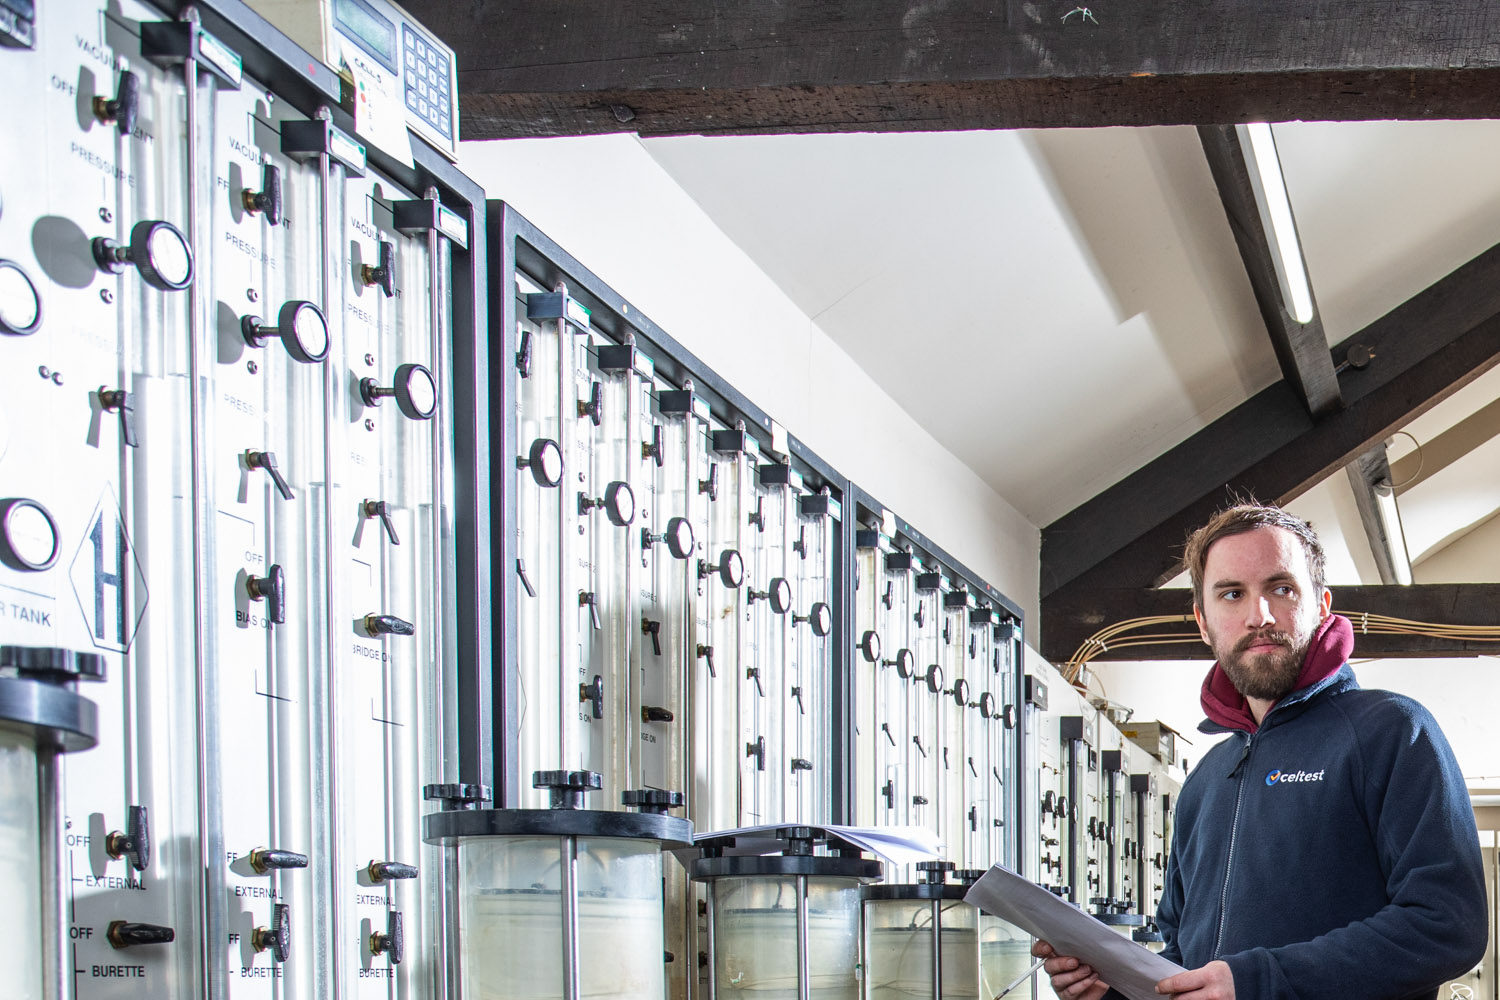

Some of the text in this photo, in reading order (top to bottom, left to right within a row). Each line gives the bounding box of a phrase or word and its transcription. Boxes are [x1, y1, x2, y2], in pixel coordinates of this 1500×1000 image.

[10, 603, 52, 628] TANK
[1280, 769, 1325, 783] celtest
[66, 834, 91, 847] OFF
[86, 875, 147, 891] EXTERNAL
[235, 885, 284, 900] EXTERNAL
[69, 926, 93, 940] OFF
[91, 965, 146, 978] BURETTE
[241, 966, 283, 979] BURETTE
[359, 967, 395, 979] BURETTE
